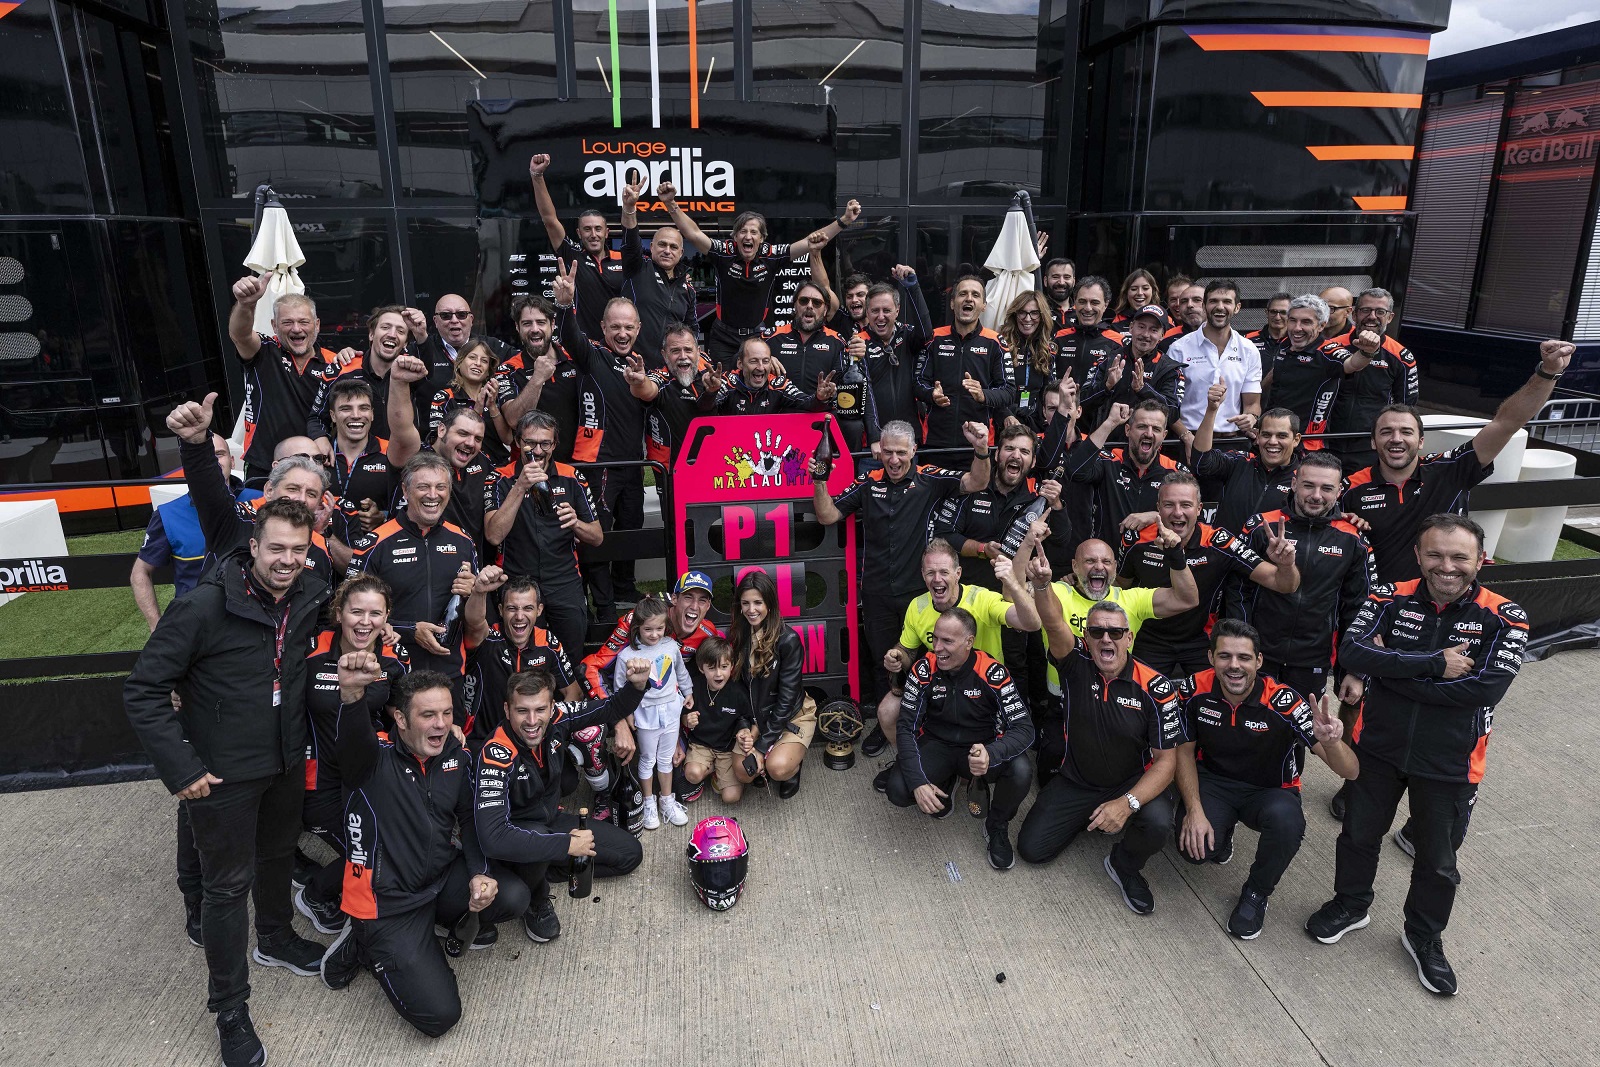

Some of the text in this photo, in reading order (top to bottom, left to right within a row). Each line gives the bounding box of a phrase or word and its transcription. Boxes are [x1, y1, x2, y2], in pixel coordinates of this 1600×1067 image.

[582, 138, 667, 158] Lounge
[583, 147, 736, 206] aprilia
[633, 200, 736, 213] RACING
[775, 267, 811, 276] AREAR
[775, 295, 794, 304] CAM
[774, 307, 796, 315] CAS
[311, 369, 324, 377] apri
[562, 370, 577, 378] aprili
[583, 391, 599, 439] aprilia
[1312, 391, 1334, 432] aprilia
[650, 414, 664, 450] aprilia
[363, 463, 387, 472] aprilia
[723, 504, 790, 560] P1
[436, 543, 457, 552] aprilia
[1318, 545, 1343, 555] aprilia
[0, 560, 68, 591] prilia
[5, 584, 69, 593] RACING
[1394, 620, 1416, 629] CASE
[1454, 621, 1482, 631] aprilia
[1117, 696, 1142, 707] aprilia
[480, 768, 500, 777] CAME
[347, 812, 369, 879] aprilia
